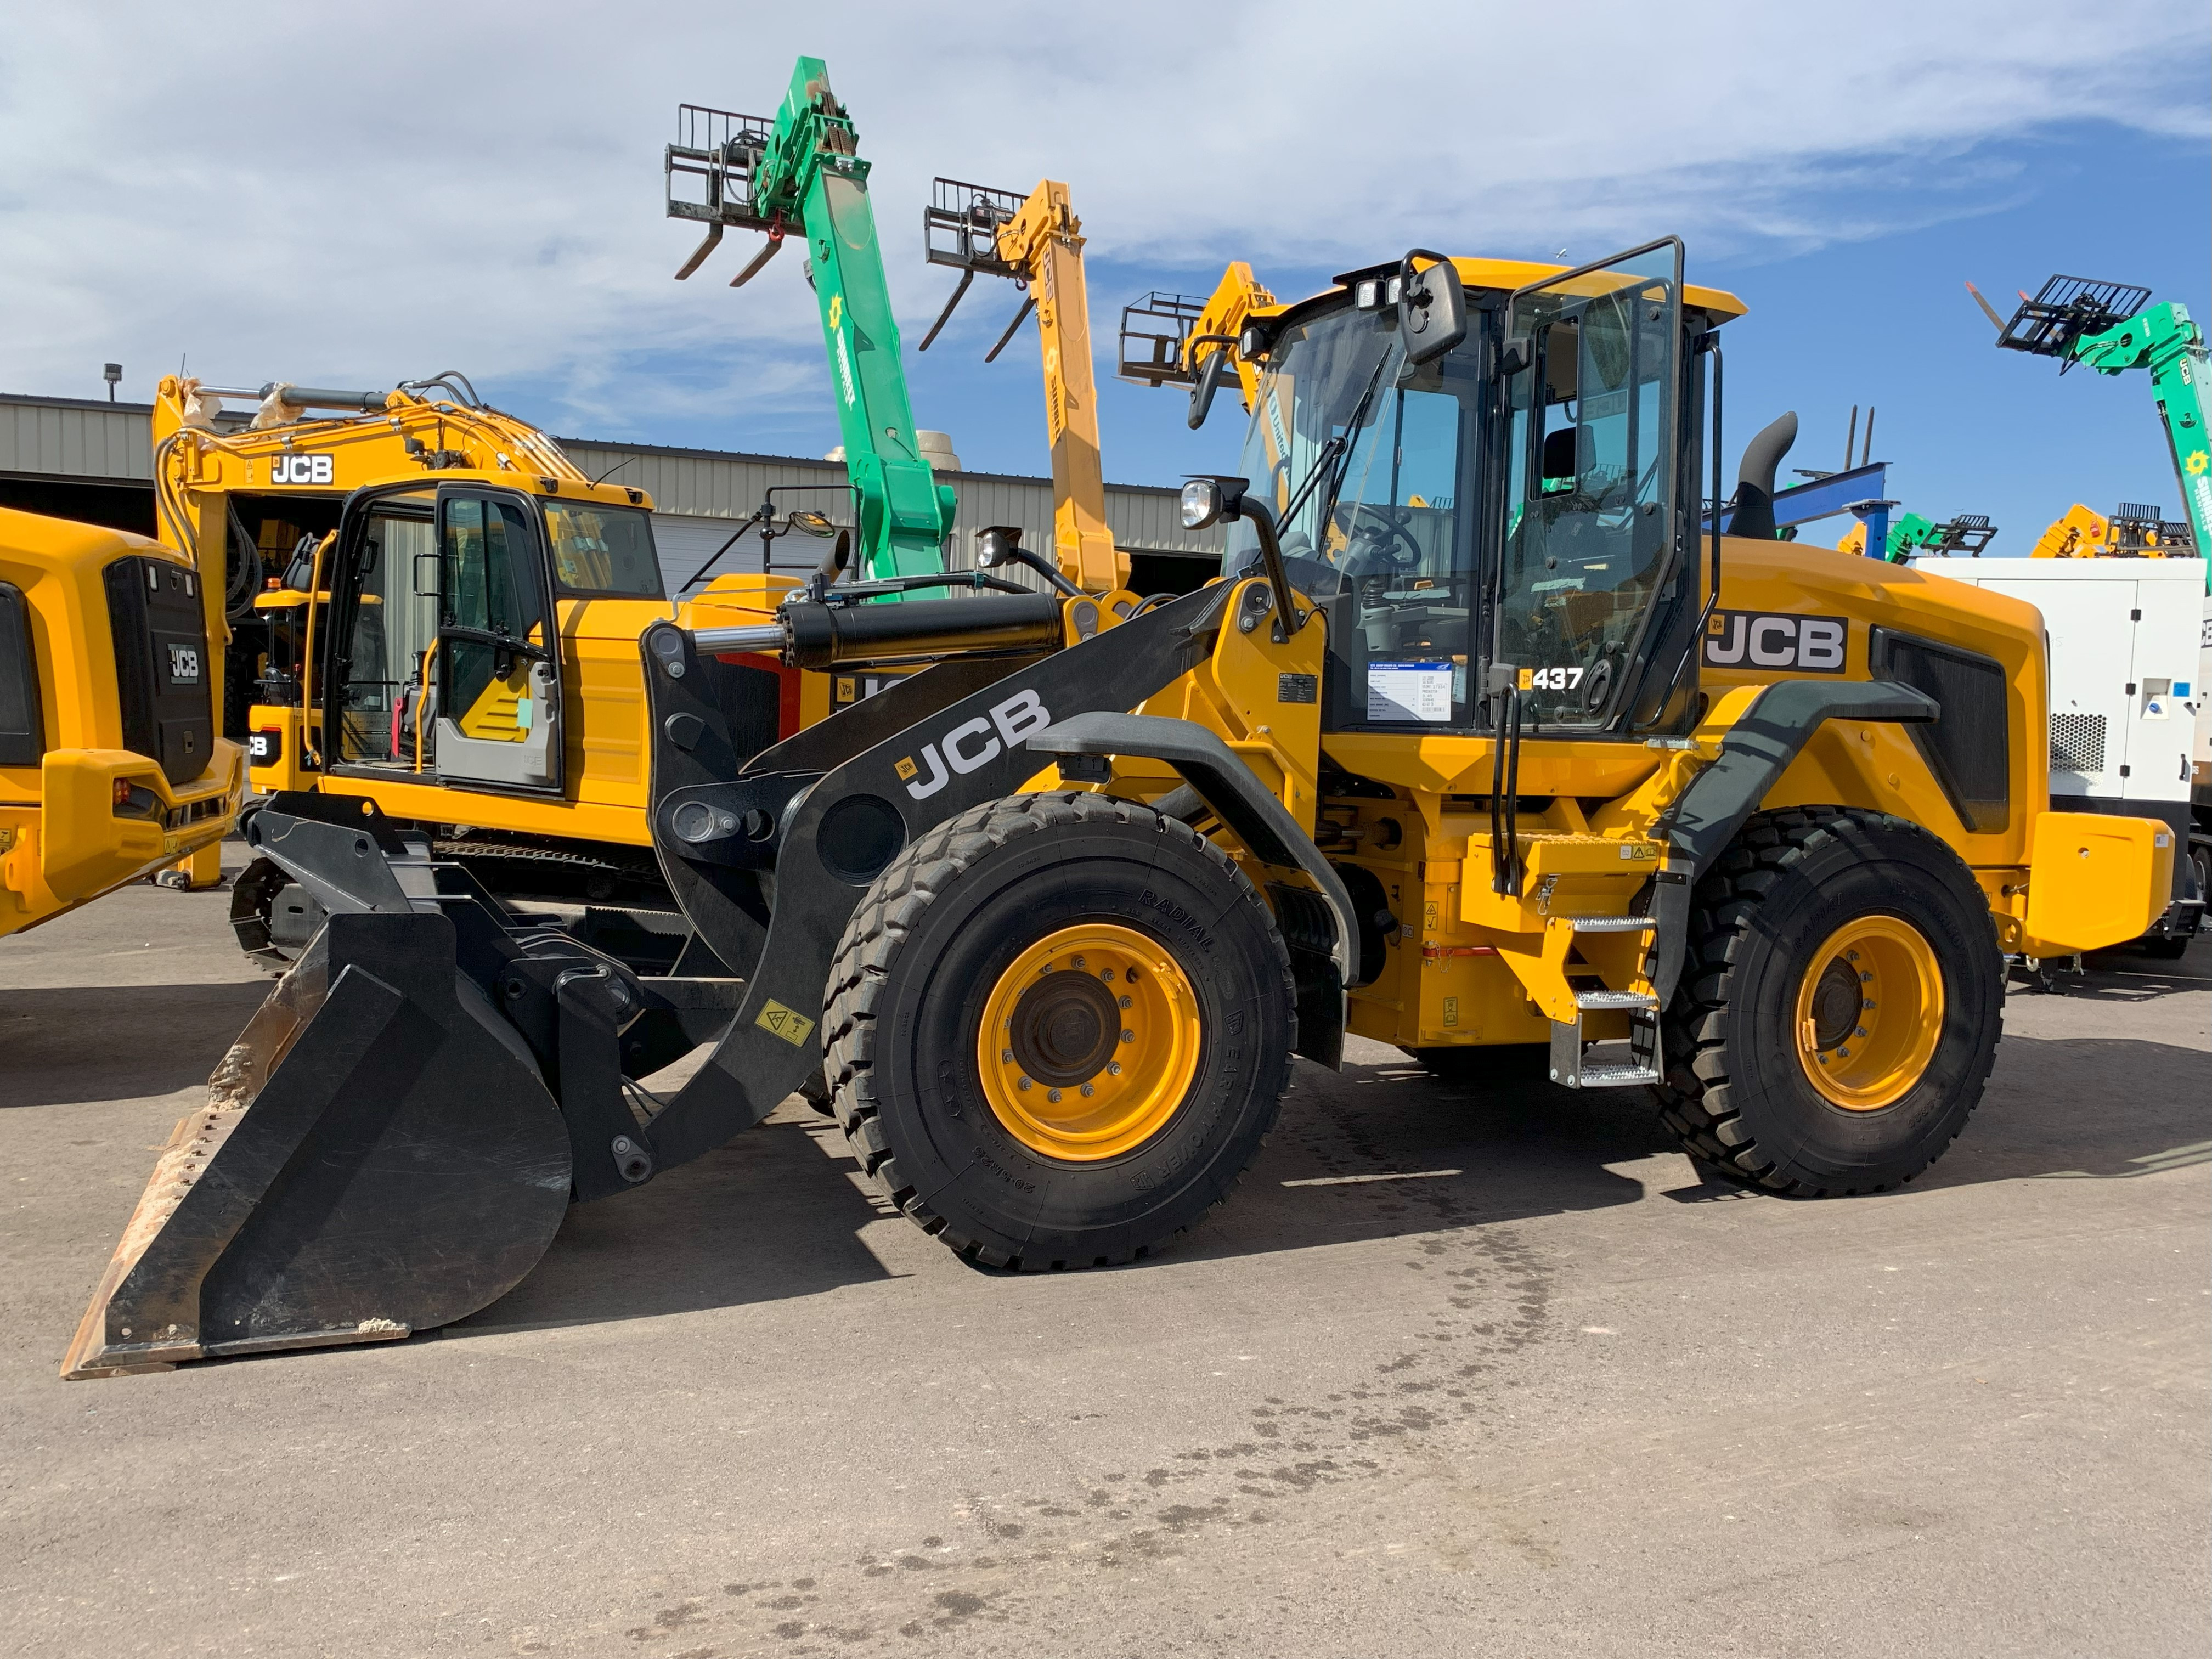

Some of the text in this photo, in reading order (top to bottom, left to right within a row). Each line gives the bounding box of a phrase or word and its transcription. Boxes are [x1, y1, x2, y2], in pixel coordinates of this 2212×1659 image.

[1043, 246, 1054, 300] JCB
[837, 326, 855, 408] SUNBELT
[2180, 359, 2191, 385] JCB
[1051, 375, 1061, 445] SUNBELT
[273, 456, 332, 483] JCB
[2194, 488, 2209, 531] RENTALS
[173, 650, 198, 677] JCB
[1707, 616, 1843, 668] JCB
[1533, 668, 1583, 690] 437
[250, 736, 267, 755] CB
[906, 689, 1051, 800] JCB
[1138, 888, 1214, 952] RADIAL
[1157, 1045, 1240, 1178] EARTHMOVER
